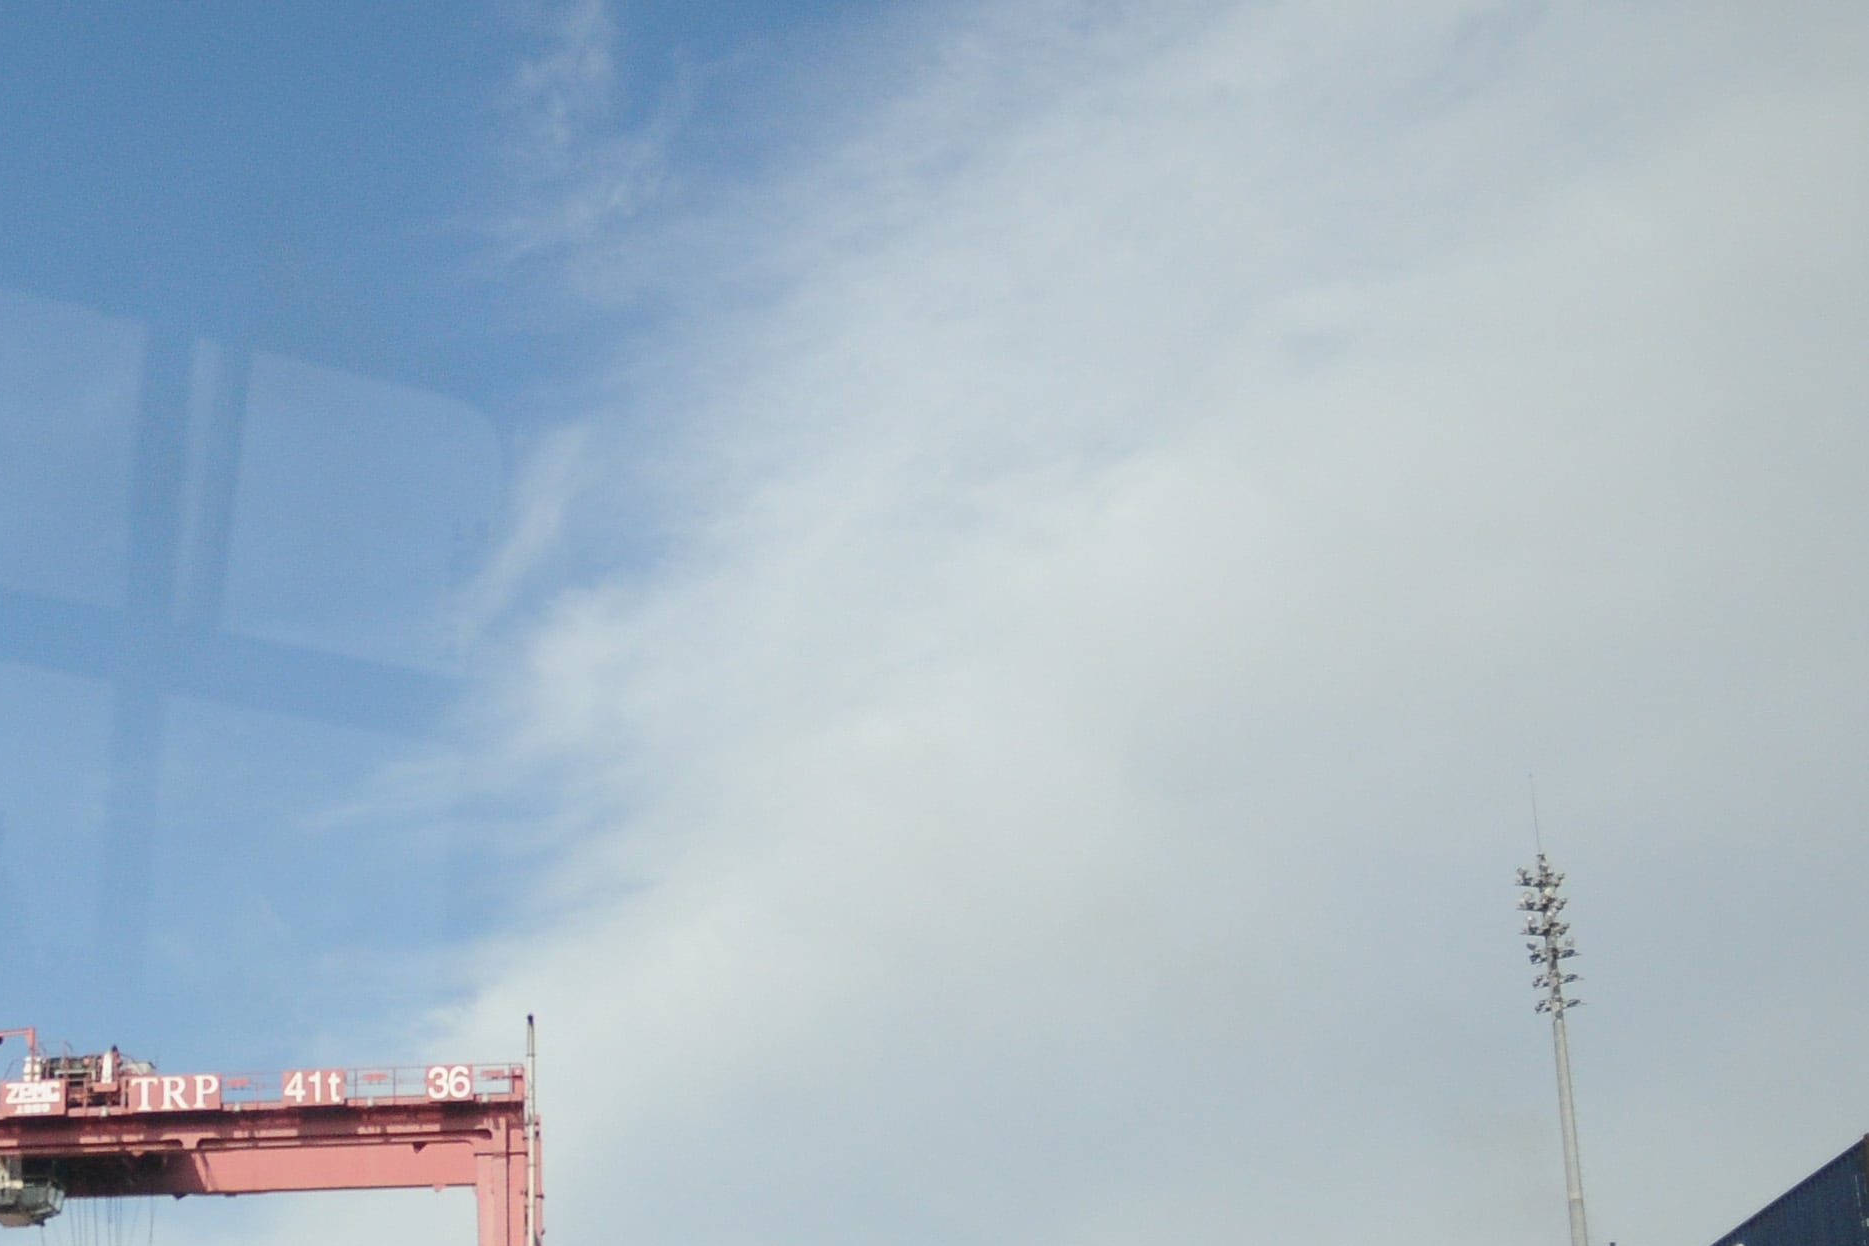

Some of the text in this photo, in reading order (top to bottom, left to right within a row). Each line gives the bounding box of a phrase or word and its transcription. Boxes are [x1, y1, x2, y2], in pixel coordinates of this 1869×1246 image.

[5, 1081, 60, 1104] ZPMC
[132, 1074, 222, 1111] TRP
[283, 1071, 343, 1104] 41t
[427, 1065, 471, 1100] 36
